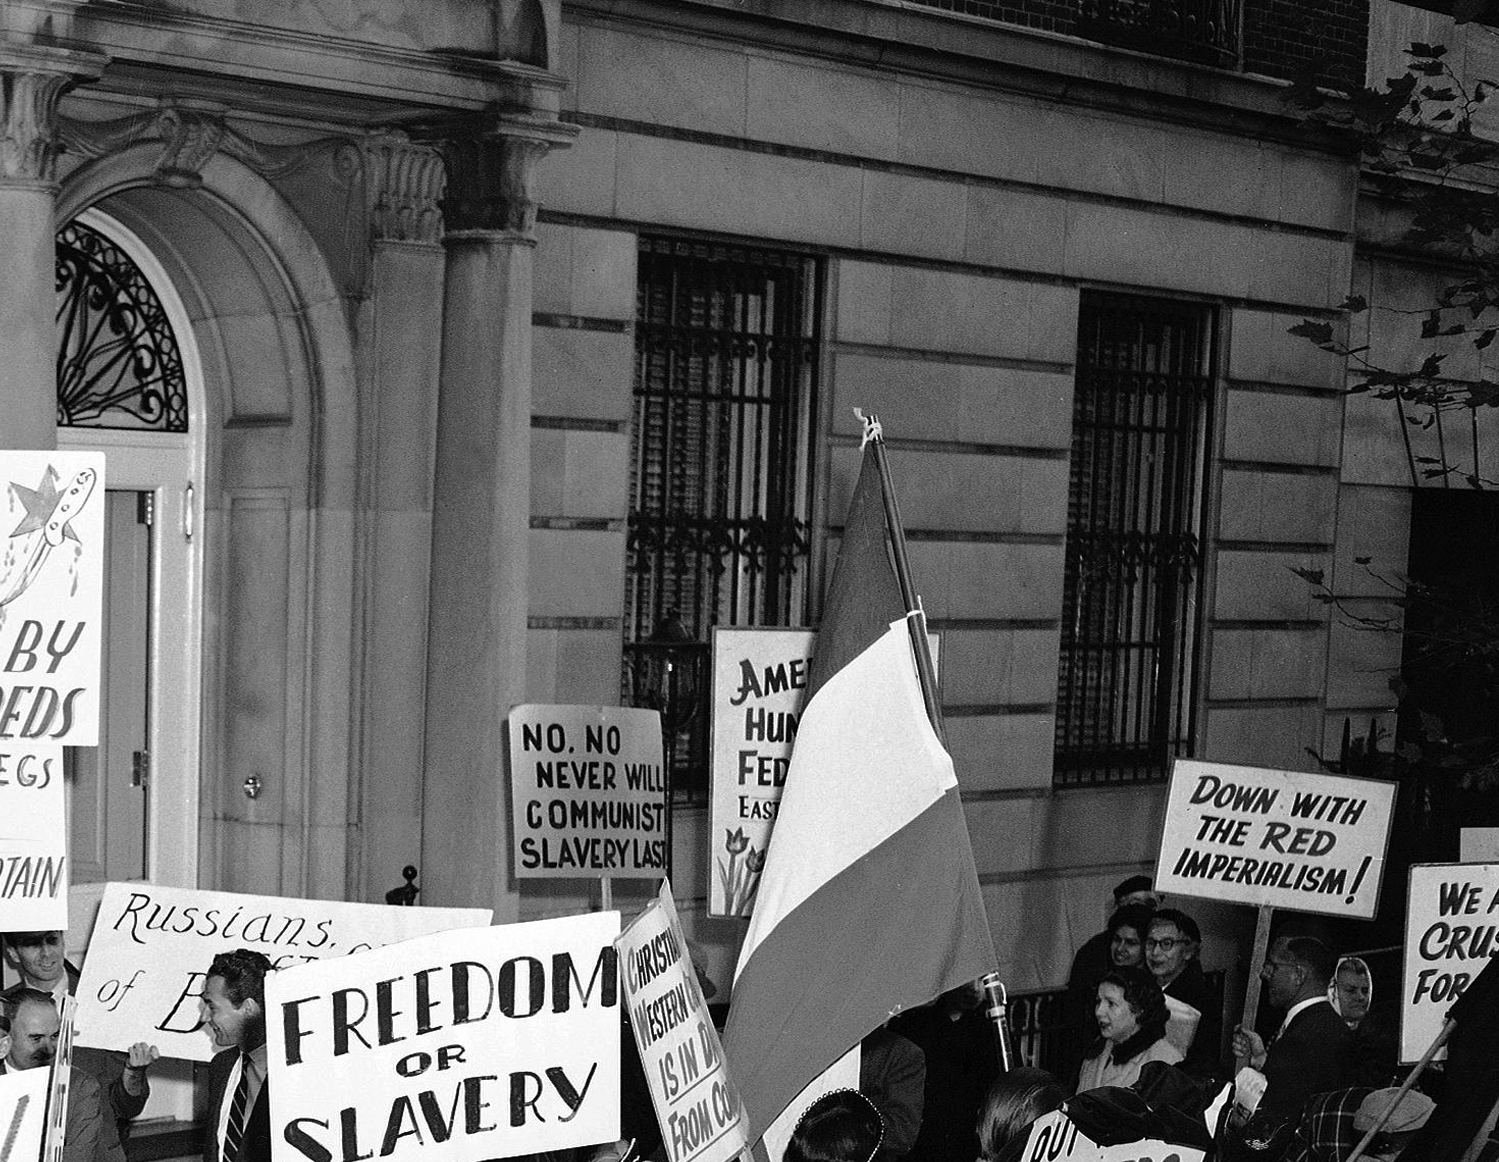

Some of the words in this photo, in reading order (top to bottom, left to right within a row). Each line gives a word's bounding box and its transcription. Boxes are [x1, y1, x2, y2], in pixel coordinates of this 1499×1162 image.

[3, 619, 87, 674] BY
[586, 725, 621, 755] NO
[536, 761, 616, 790] NEVER
[624, 763, 664, 792] WILL
[526, 799, 664, 832] COMMUNIST
[1190, 775, 1280, 814] DOWN
[1290, 792, 1367, 825] WITH
[521, 837, 630, 869] SLAVERY
[1196, 815, 1252, 846] THE
[1259, 821, 1337, 857] RED
[1172, 848, 1372, 904] IMPERIALISM!
[1439, 882, 1483, 917] WE
[96, 970, 146, 1012] of
[281, 946, 619, 1066] FREEDOM
[633, 983, 689, 1051] WESTERN
[395, 1044, 467, 1078] OR
[659, 1051, 679, 1101] IS
[678, 1037, 699, 1086] IN
[668, 1099, 713, 1162] FROM
